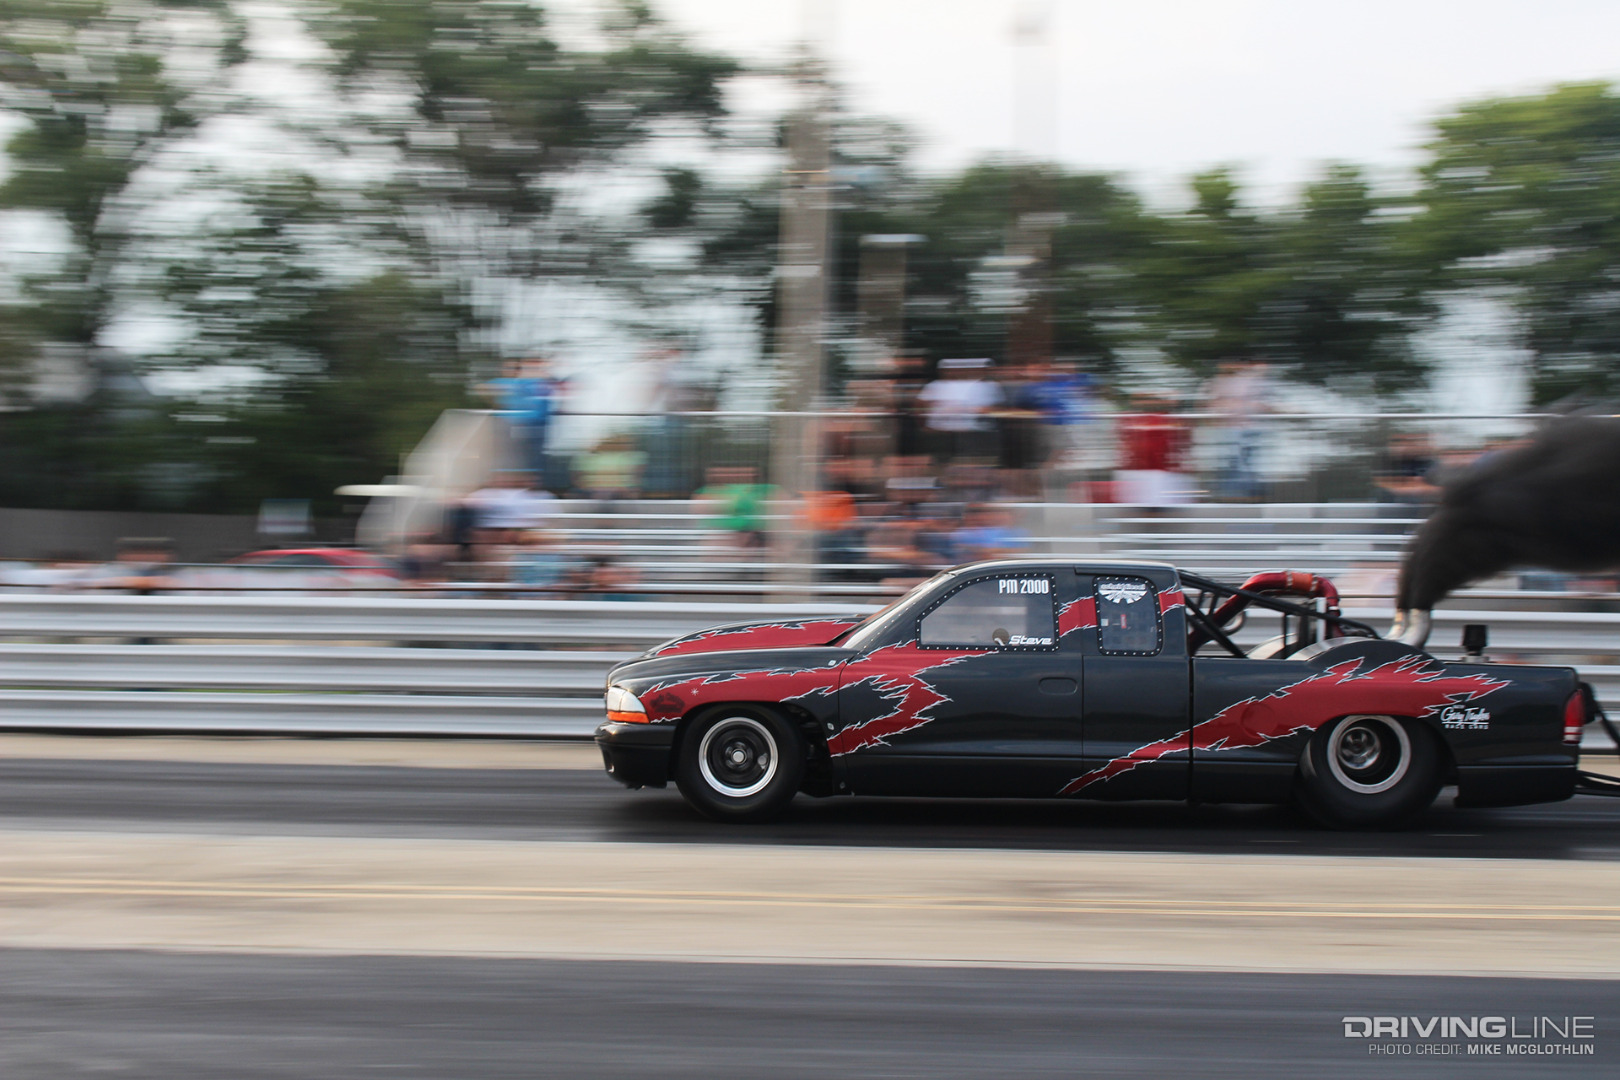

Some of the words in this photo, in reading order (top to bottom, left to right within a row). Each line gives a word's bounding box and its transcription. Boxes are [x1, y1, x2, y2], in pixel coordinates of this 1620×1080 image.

[998, 579, 1018, 594] PM
[1019, 579, 1049, 594] 2000
[1008, 635, 1053, 646] Steve
